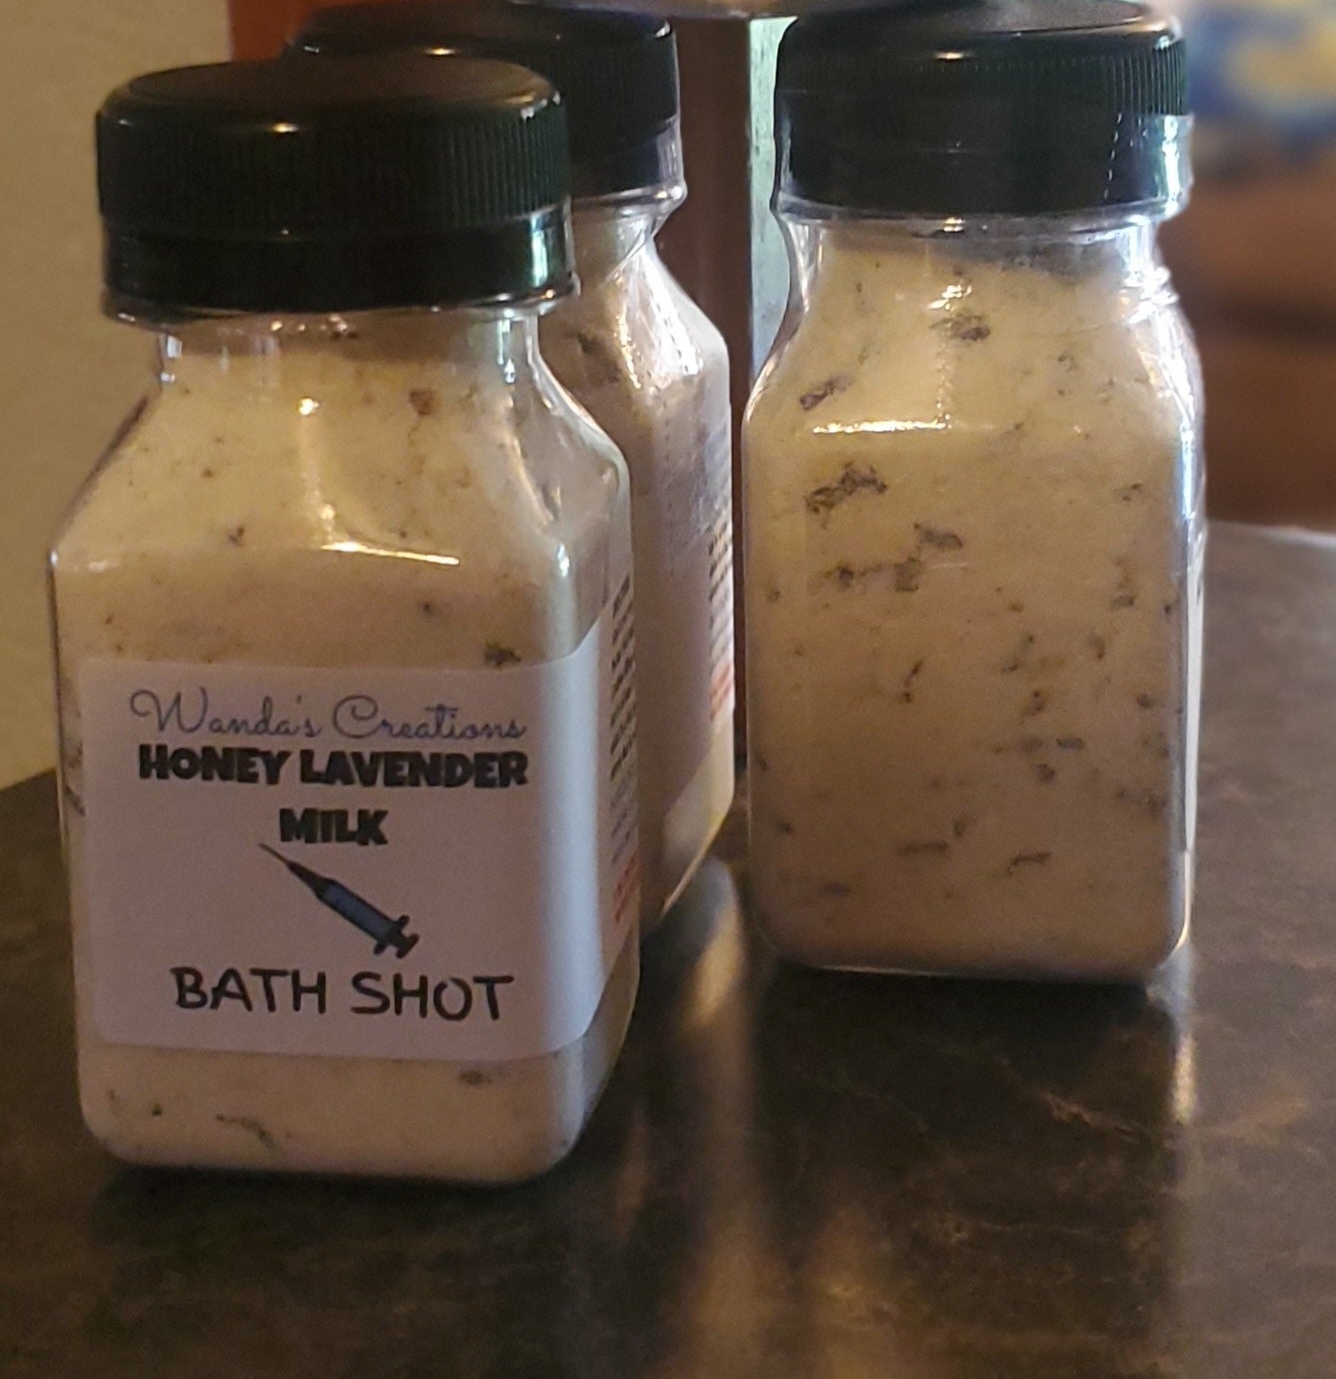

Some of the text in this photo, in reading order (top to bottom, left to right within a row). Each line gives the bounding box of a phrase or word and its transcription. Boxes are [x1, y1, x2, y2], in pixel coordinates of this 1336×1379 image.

[129, 687, 527, 742] Wanda's Creations
[138, 744, 529, 789] HONEY LAVENDER
[279, 808, 388, 846] MILK
[170, 966, 514, 1022] BATH SHOT
